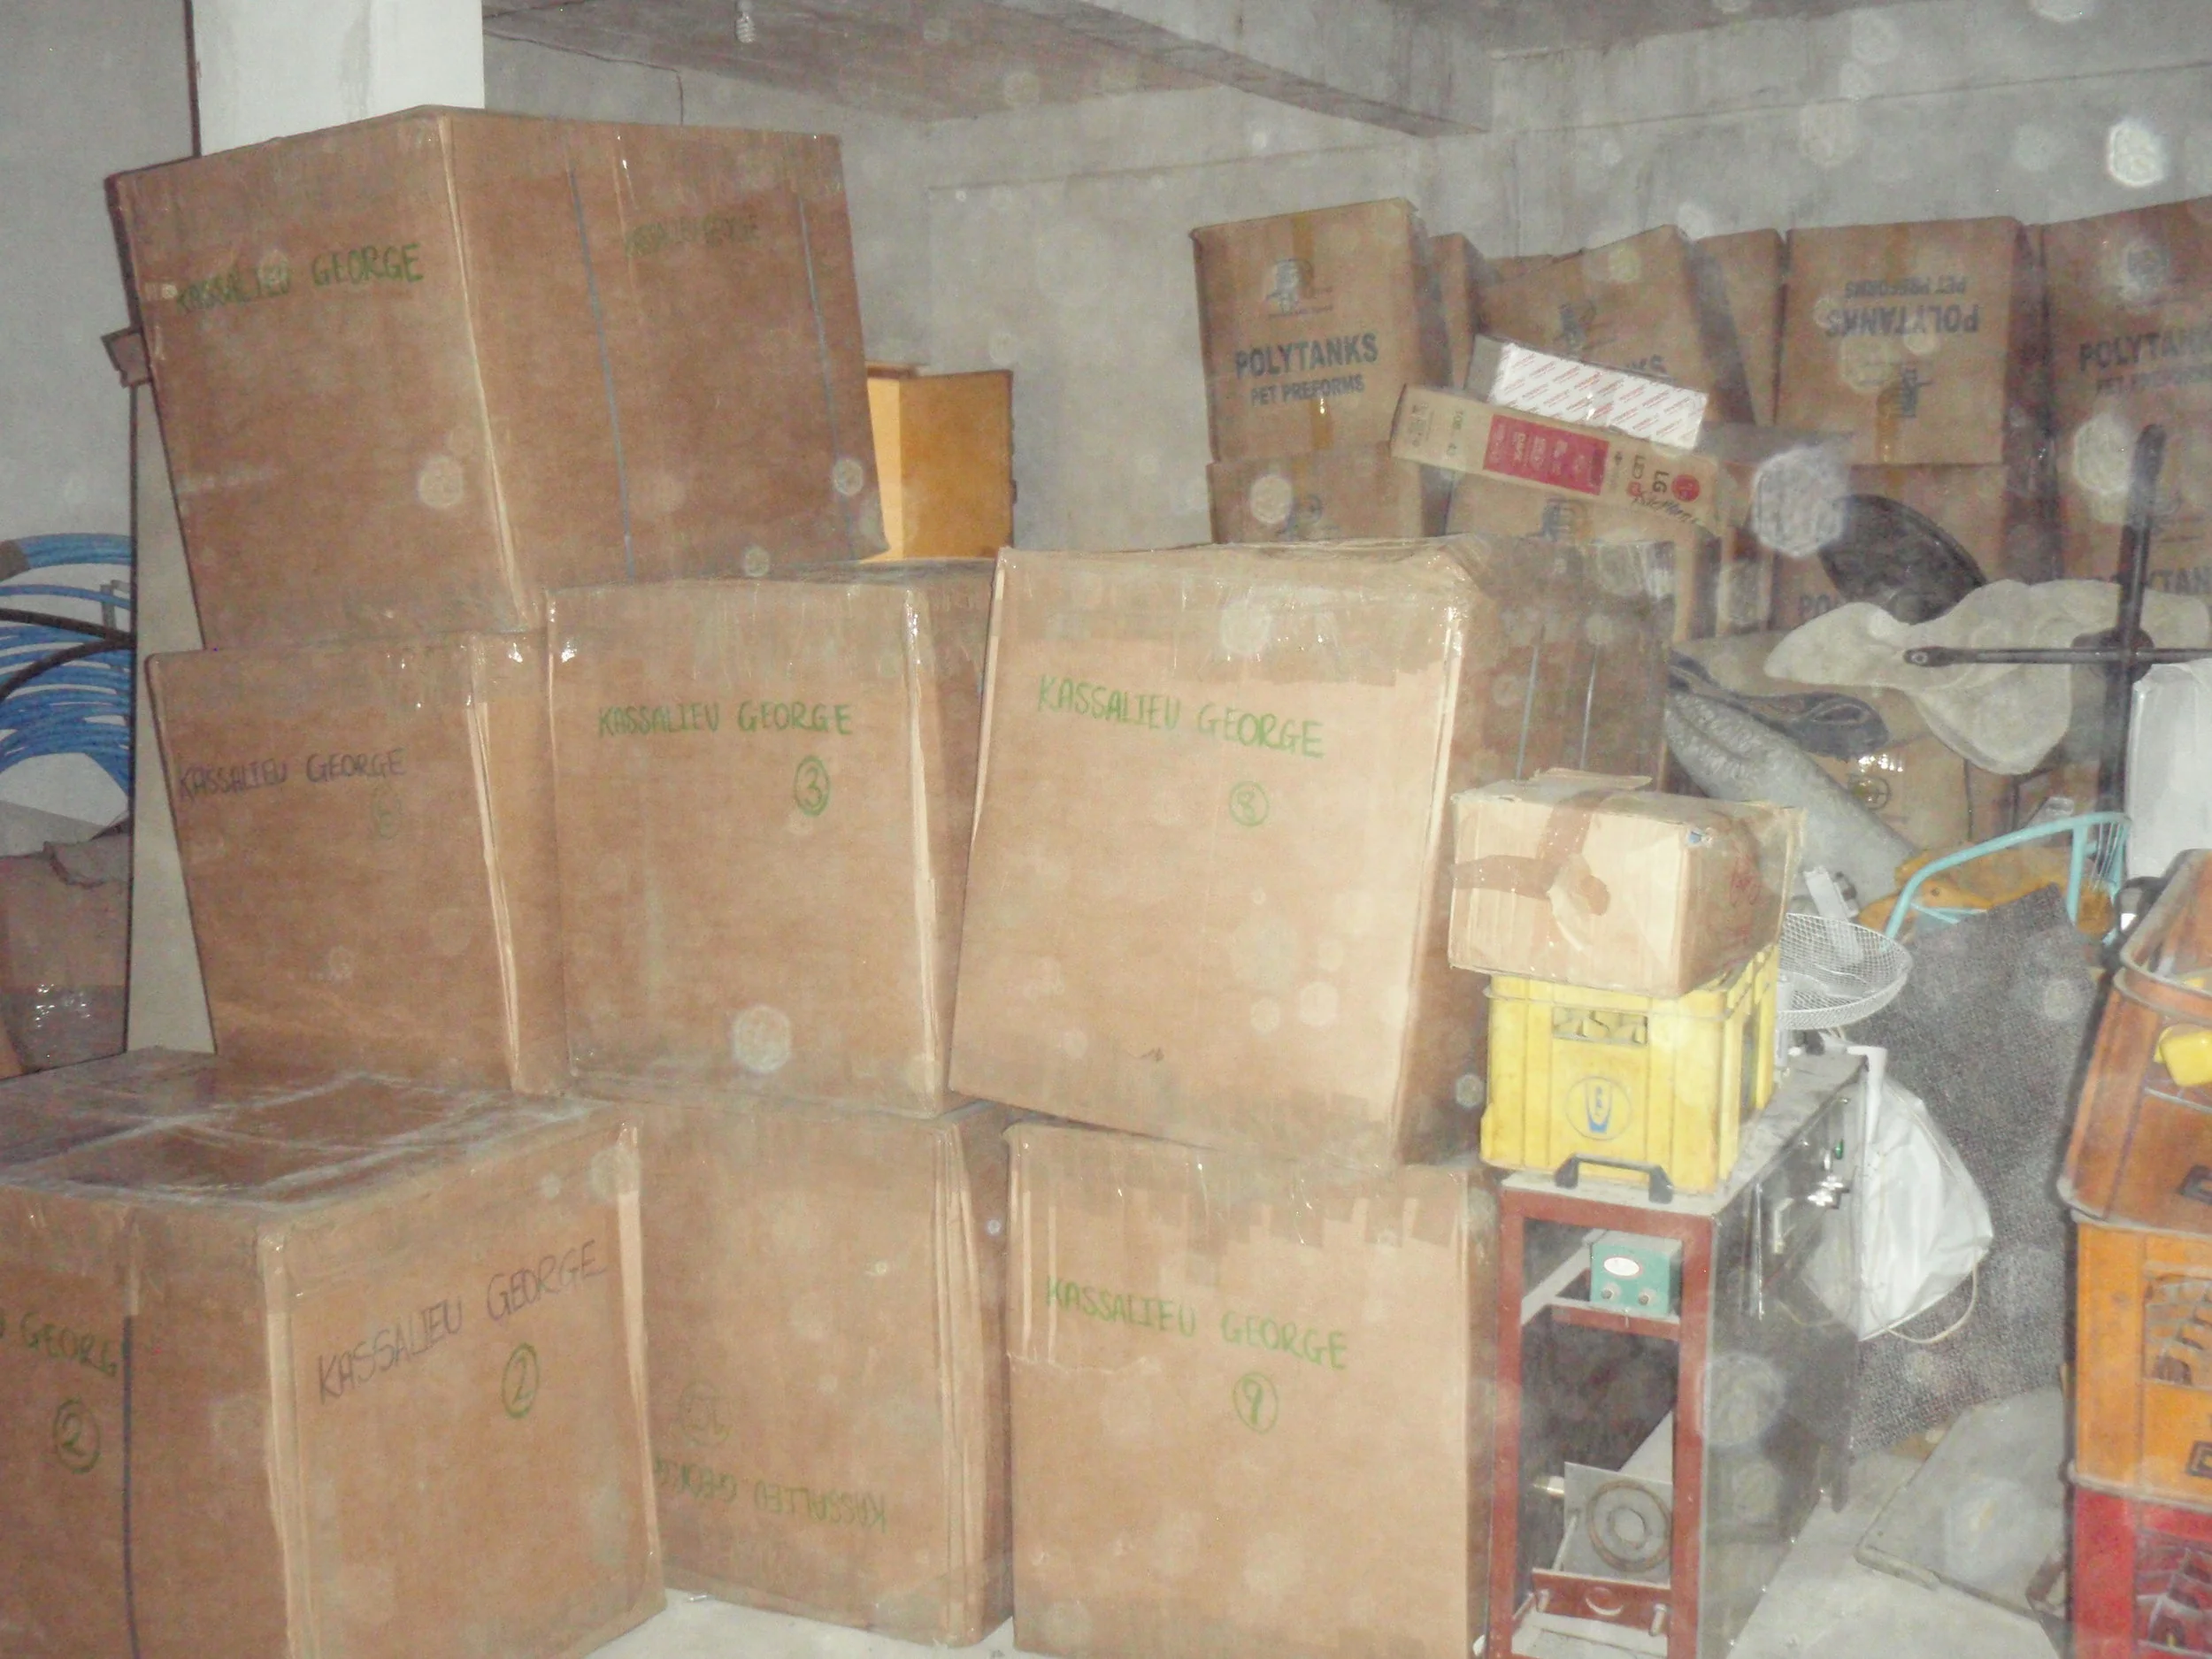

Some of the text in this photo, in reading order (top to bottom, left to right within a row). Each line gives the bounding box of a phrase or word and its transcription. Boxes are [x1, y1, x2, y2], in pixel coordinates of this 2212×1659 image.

[311, 242, 423, 287] GEORGE
[1234, 332, 1379, 380] POLYTANKS
[1249, 373, 1365, 408] PET PREFORMS
[1651, 470, 1670, 494] LG
[598, 700, 853, 737] KASSALIEU GEORGE
[1038, 673, 1325, 759] KASSALIEU GEORGE
[305, 748, 407, 783] GEORGE
[317, 1239, 607, 1405] KASSALIEU GEORGE
[1047, 1275, 1348, 1371] KASSALIEU GEORGE
